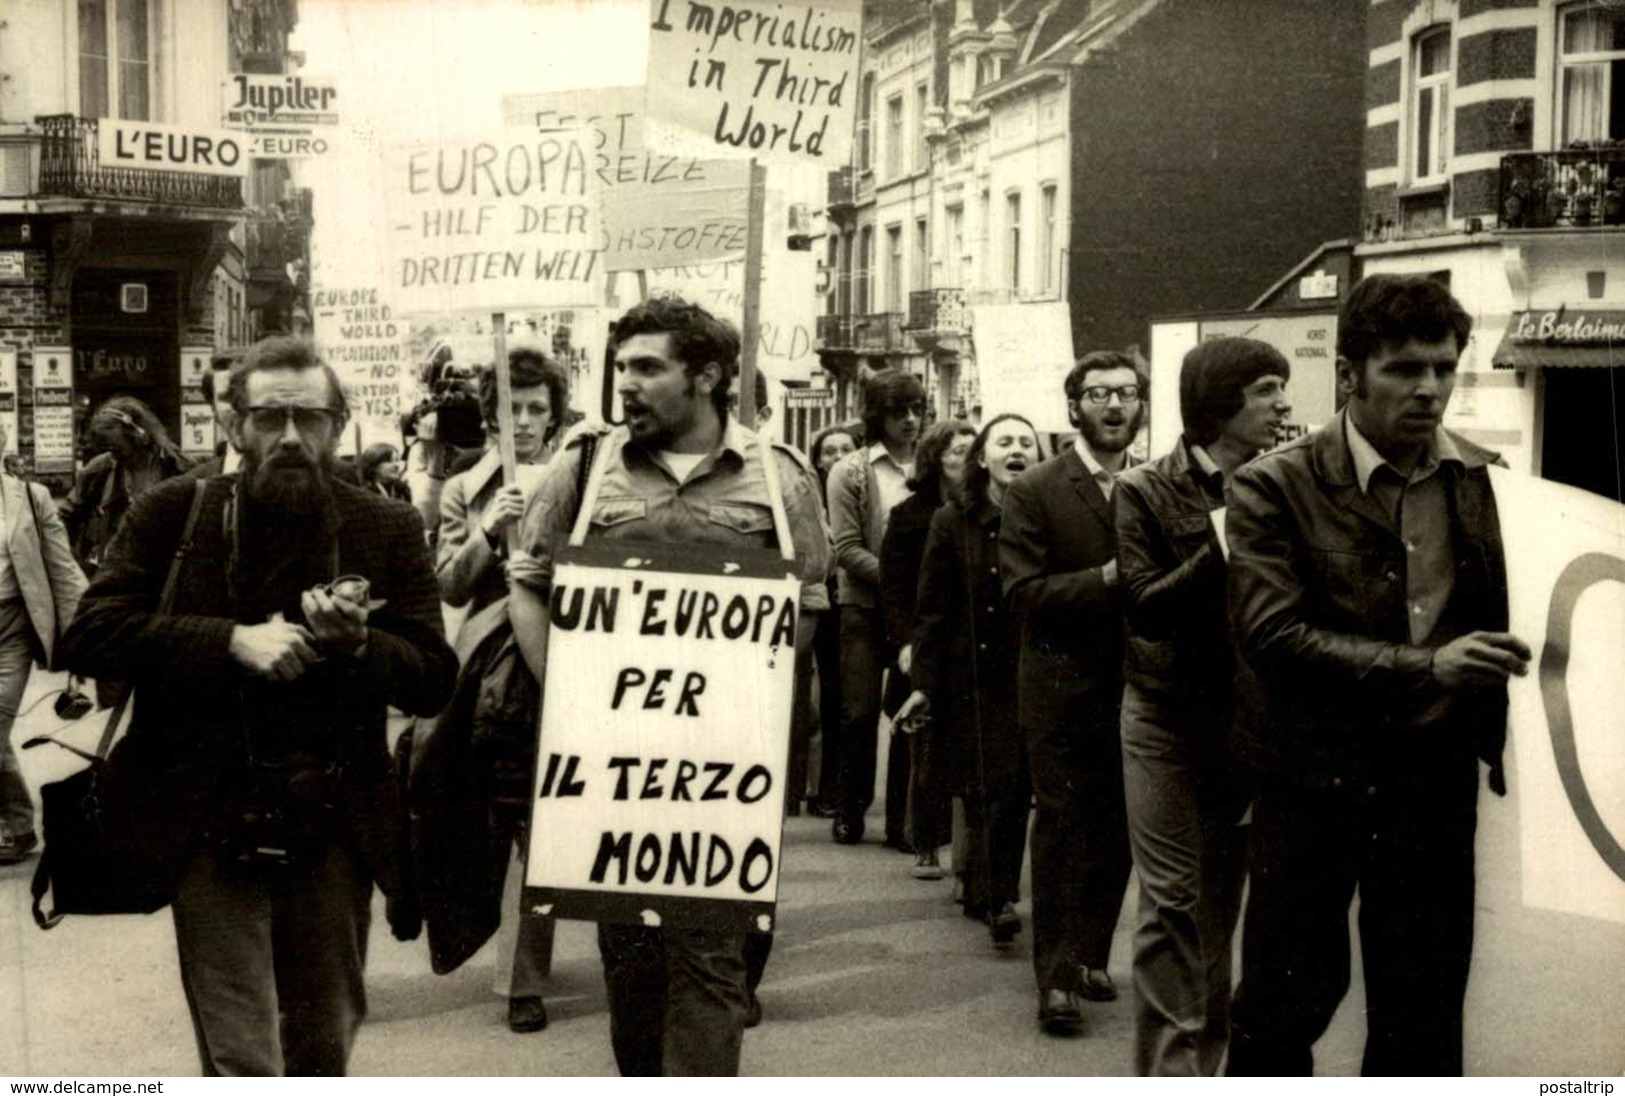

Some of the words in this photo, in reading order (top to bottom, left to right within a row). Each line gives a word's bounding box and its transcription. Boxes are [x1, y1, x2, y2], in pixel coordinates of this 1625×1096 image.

[651, 0, 855, 54] Imperialism
[232, 75, 336, 117] Jupiler
[689, 47, 726, 91] in
[752, 57, 848, 107] Third
[115, 129, 240, 167] L'EURO
[714, 101, 829, 156] World
[408, 139, 586, 197] EUROPA
[515, 204, 589, 234] DER
[402, 250, 525, 287] DRITTEN
[535, 248, 606, 282] WELT
[314, 288, 378, 307] EUROPE
[342, 305, 391, 322] THIRD
[340, 323, 397, 339] WORLD
[1509, 312, 1536, 339] Le
[365, 397, 401, 417] YES!
[550, 580, 796, 648] UN'EUROPA
[611, 667, 707, 717] PER
[539, 752, 587, 799] IL
[608, 756, 773, 804] TERZO
[589, 830, 774, 894] MONDO
